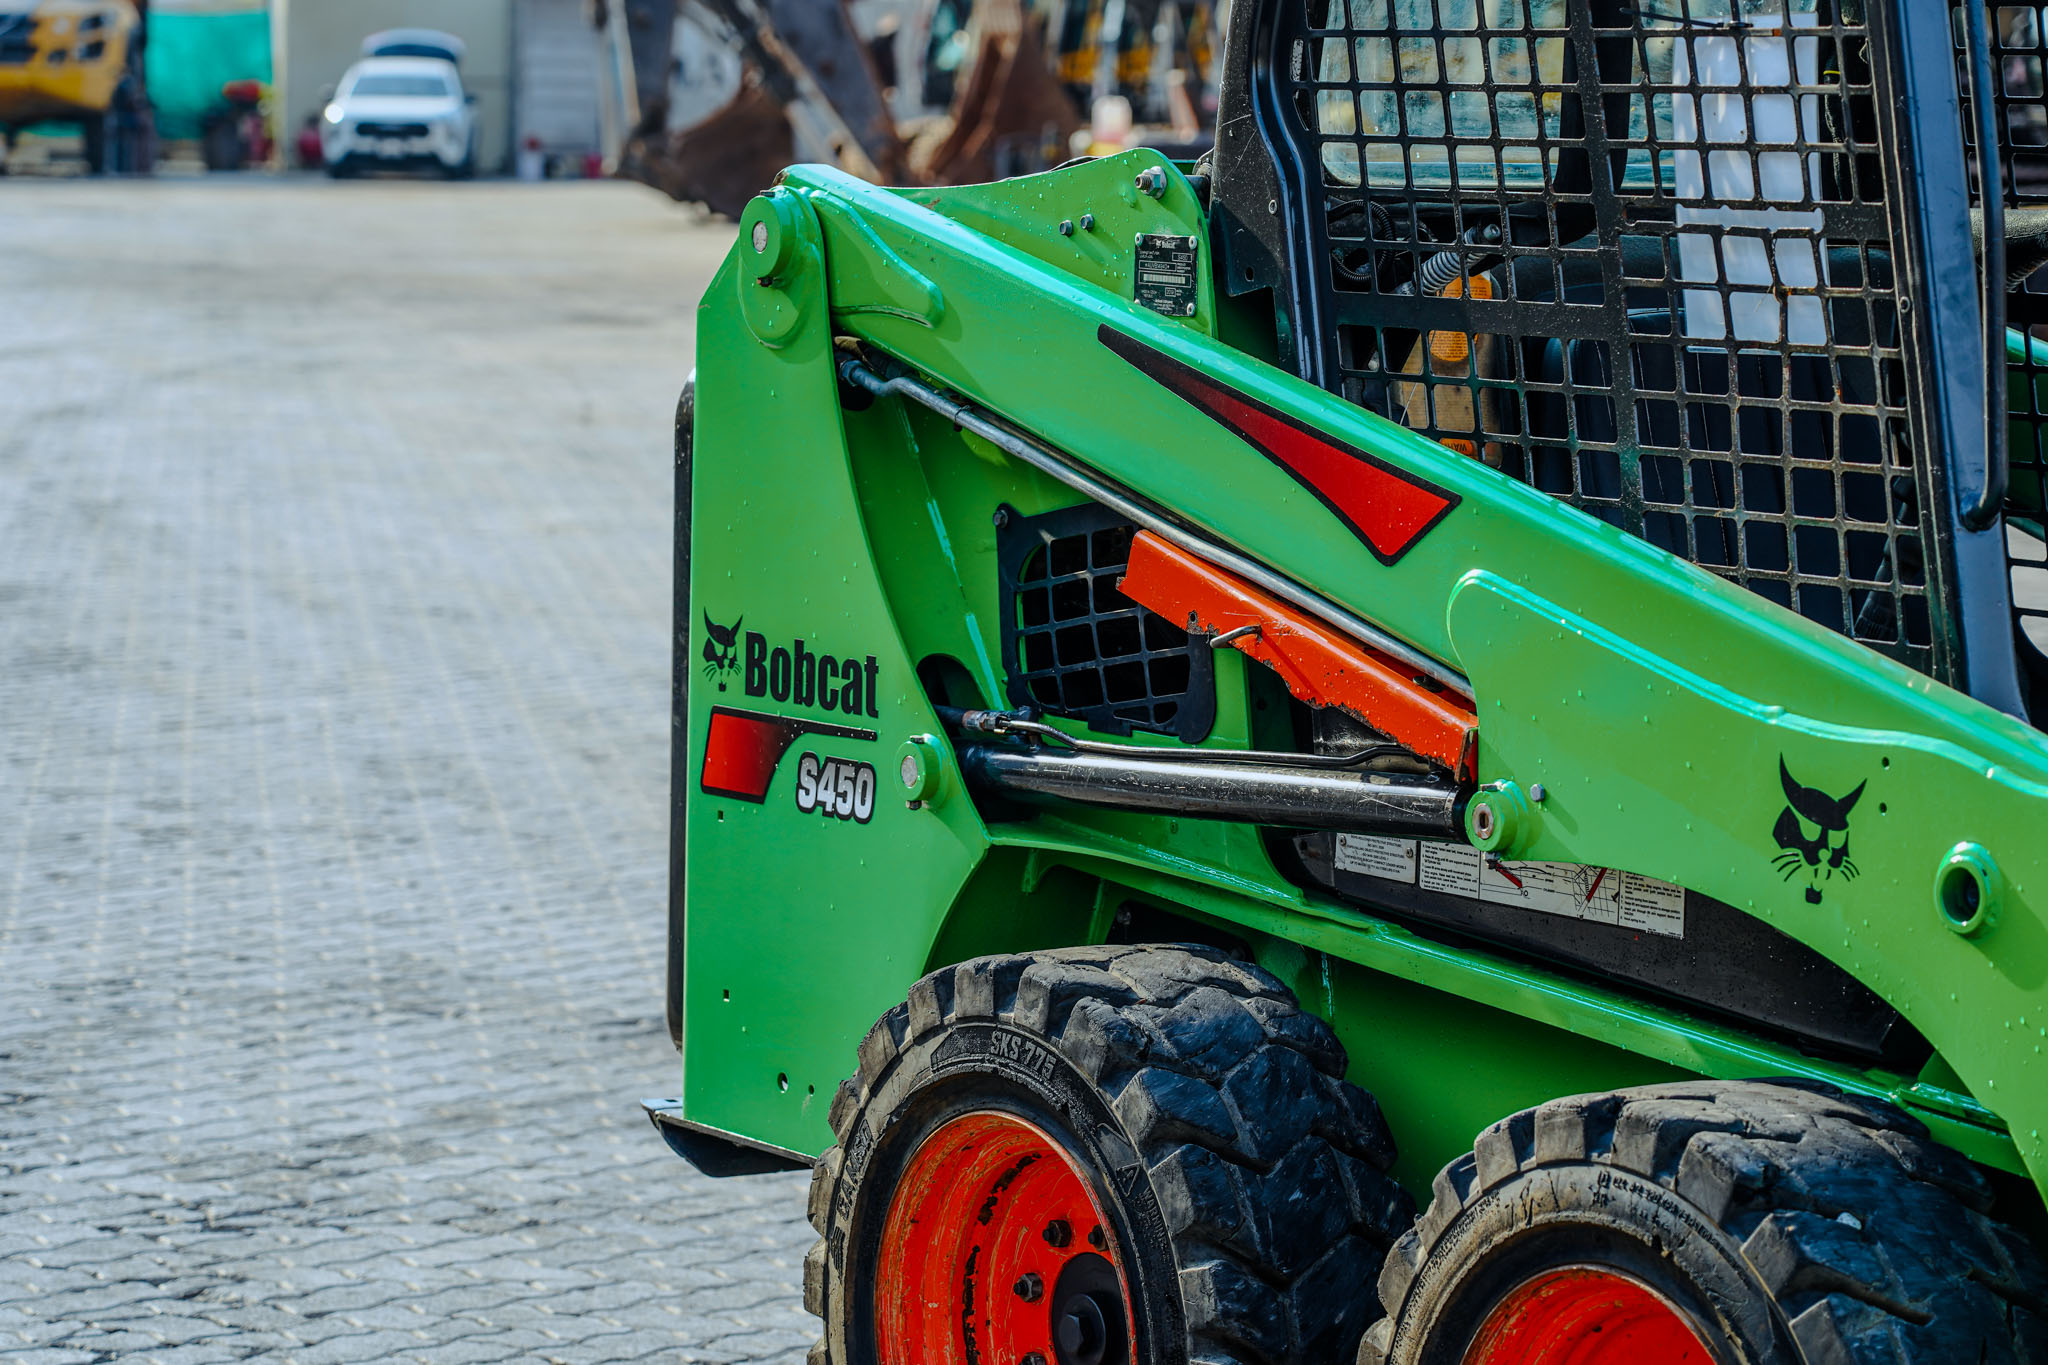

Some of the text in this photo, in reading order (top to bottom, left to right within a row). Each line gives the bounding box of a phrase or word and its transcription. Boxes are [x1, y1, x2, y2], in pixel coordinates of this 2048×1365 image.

[745, 630, 879, 719] Bobcat
[797, 751, 876, 823] S450
[990, 1030, 1057, 1080] SKS 775
